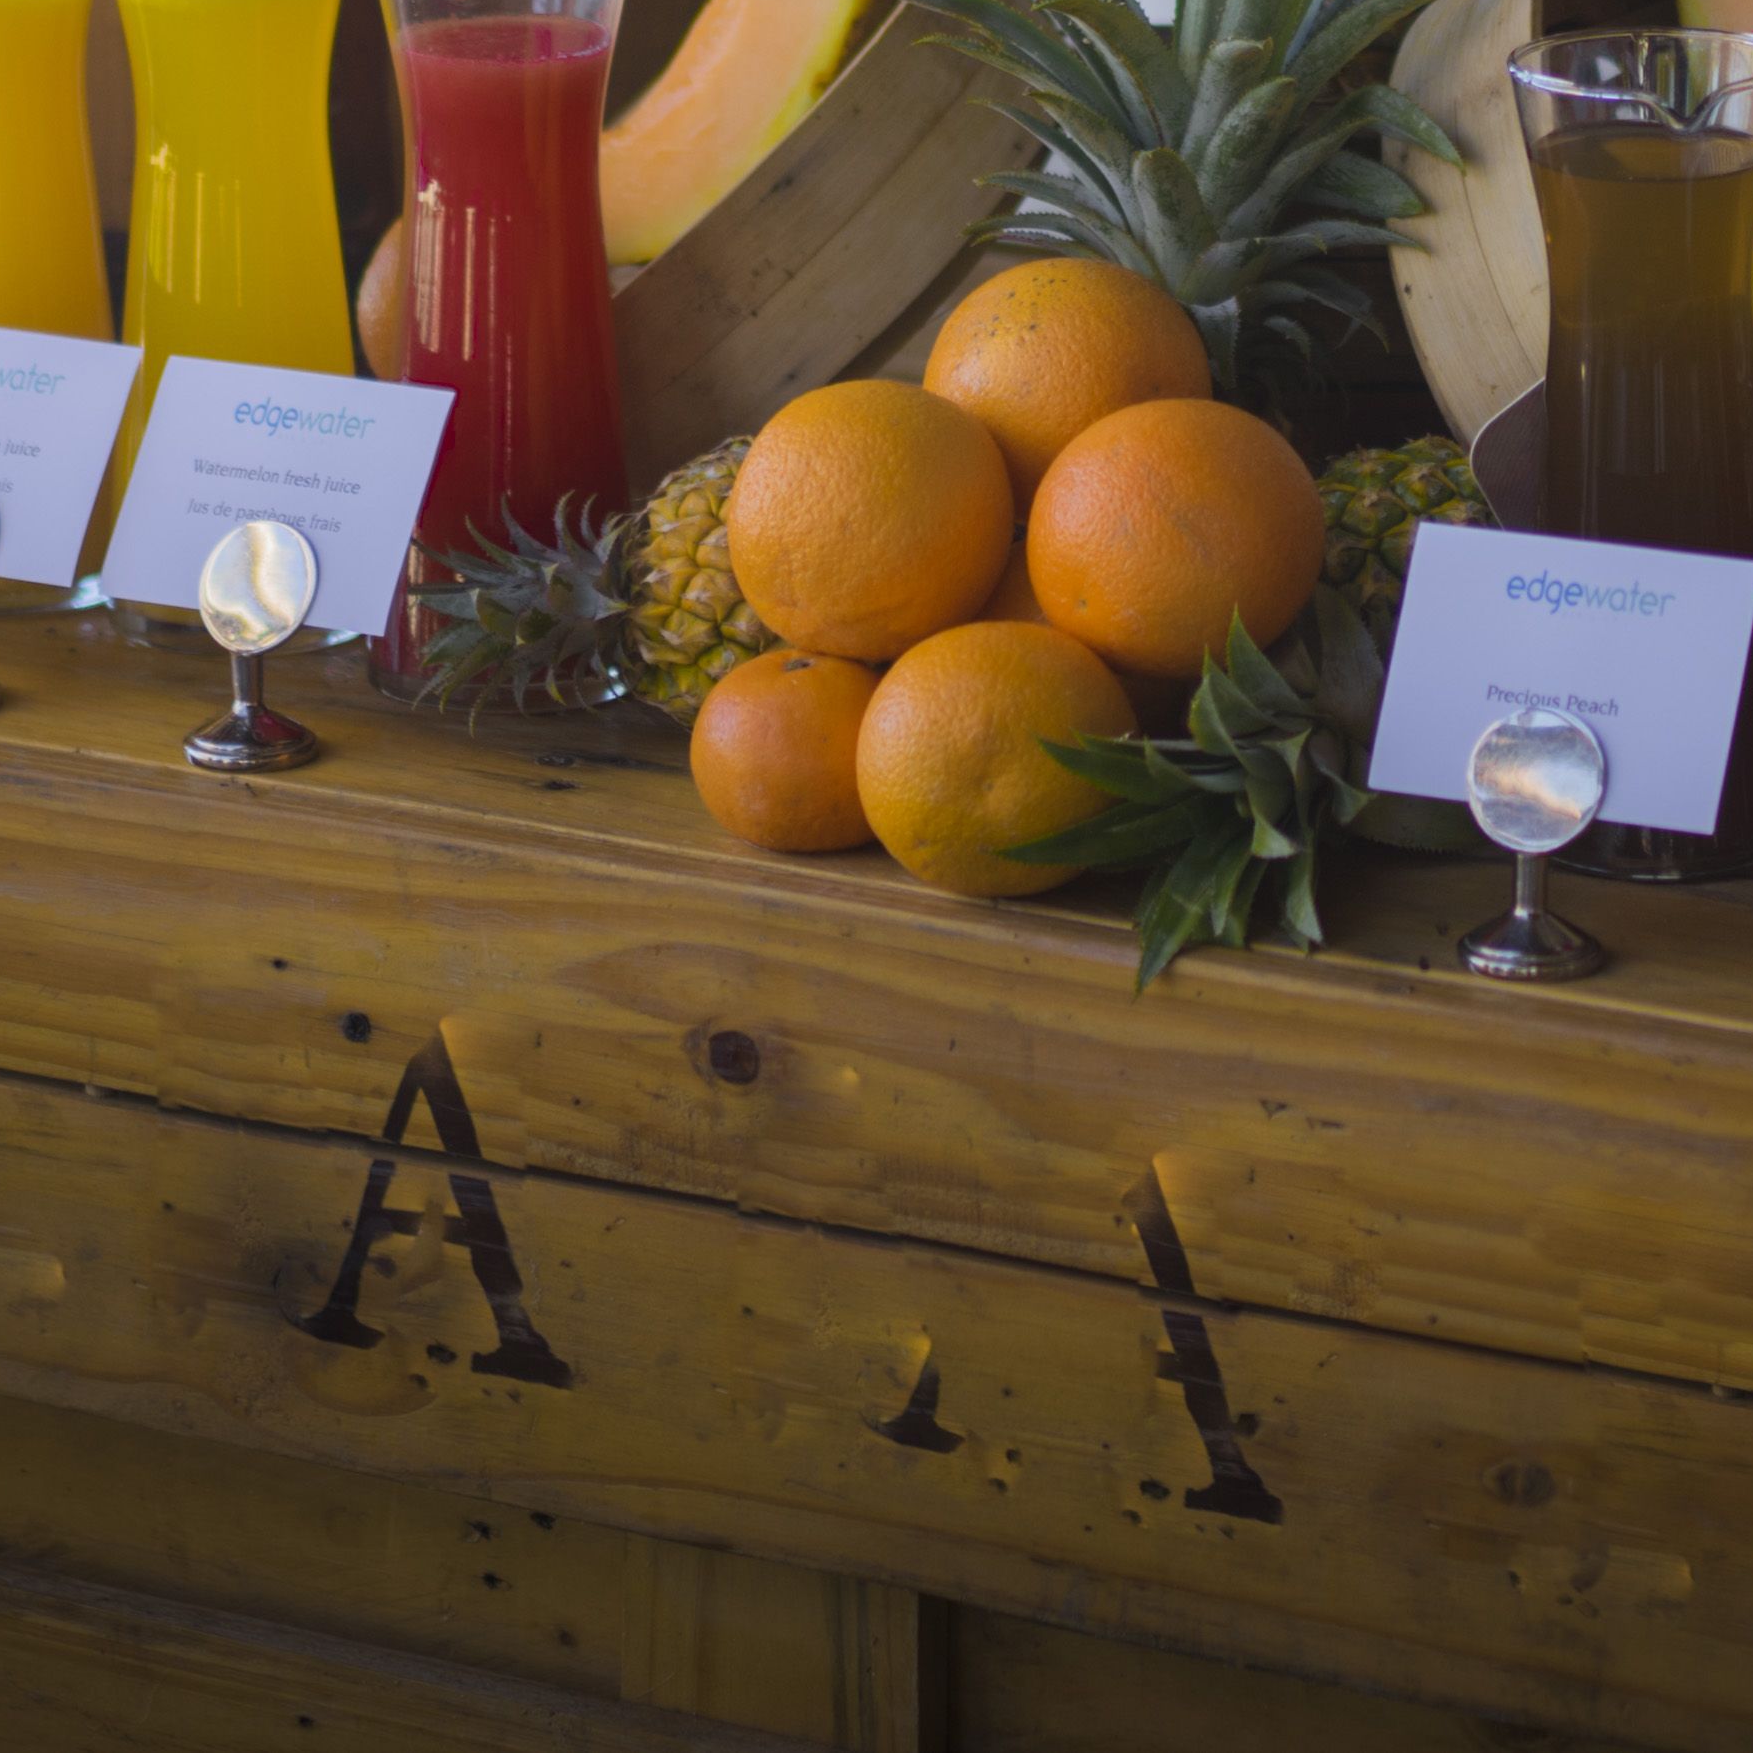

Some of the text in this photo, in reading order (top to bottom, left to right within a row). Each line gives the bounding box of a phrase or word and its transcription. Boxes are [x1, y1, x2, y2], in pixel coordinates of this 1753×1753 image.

[234, 397, 376, 439] edgewater
[3, 439, 42, 458] juice
[193, 458, 362, 496] Watermelon fresh juice
[187, 498, 210, 515] Jus
[213, 500, 233, 518] de
[309, 513, 342, 534] frais
[1505, 570, 1676, 618] edgewater
[1486, 684, 1621, 717] Precious Peach
[277, 1028, 573, 1389] A
